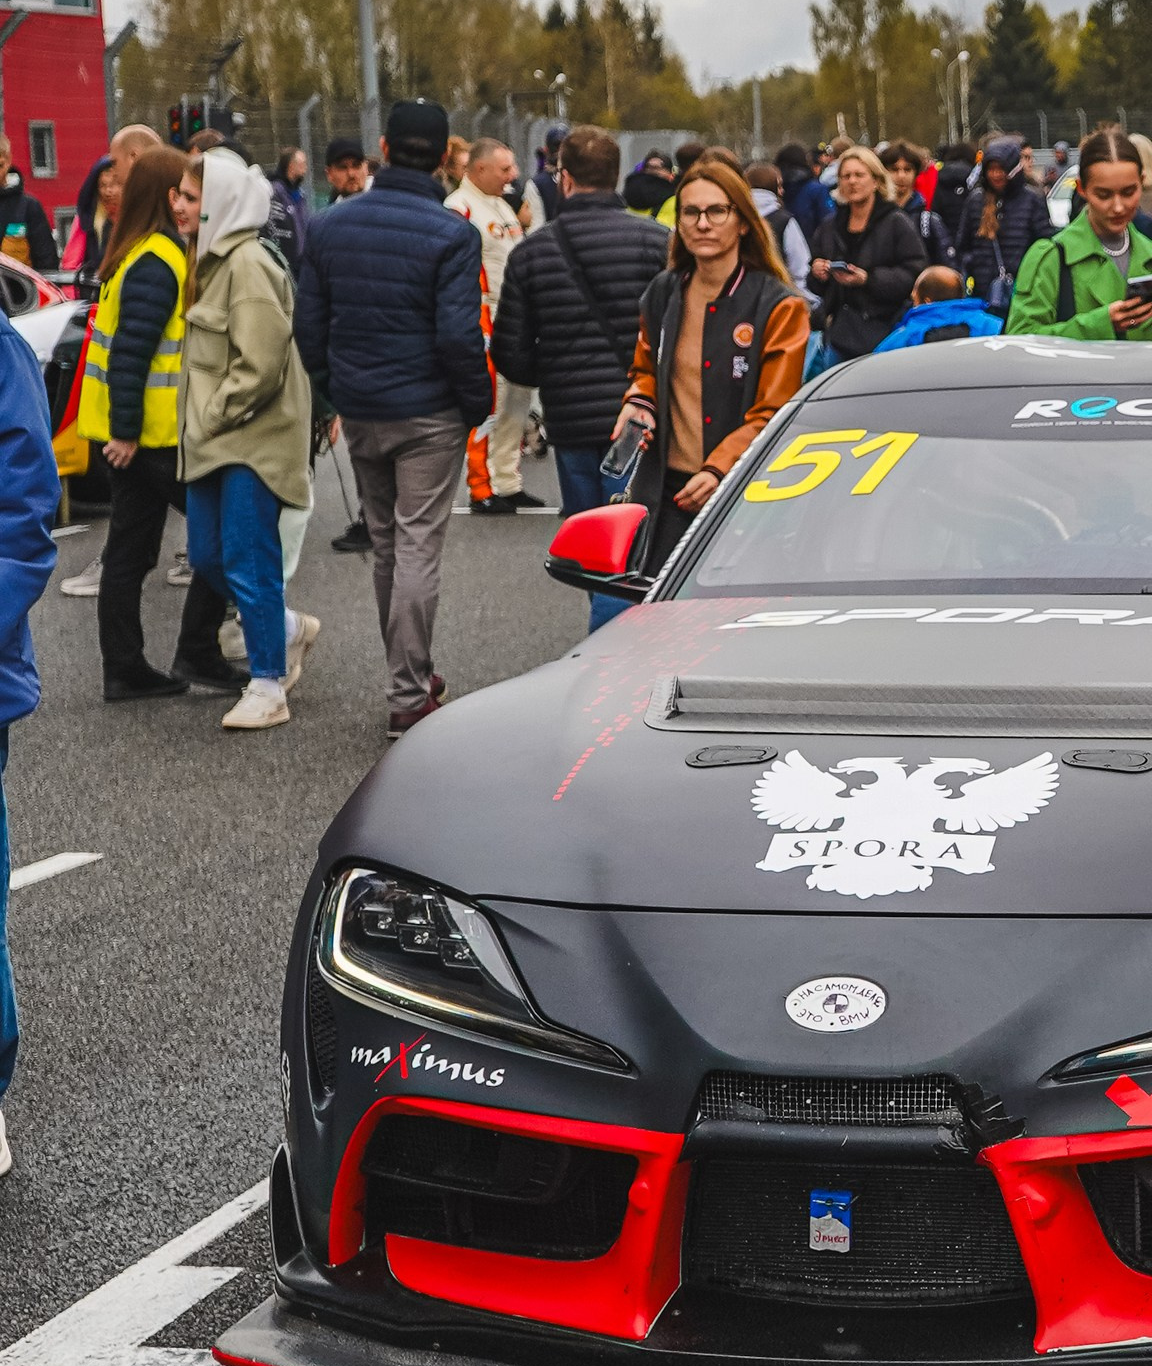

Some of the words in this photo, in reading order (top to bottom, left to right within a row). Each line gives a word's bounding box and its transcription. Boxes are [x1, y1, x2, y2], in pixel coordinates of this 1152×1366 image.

[743, 428, 919, 503] 51
[796, 1008, 823, 1023] ЭТО
[838, 1007, 870, 1026] BMW
